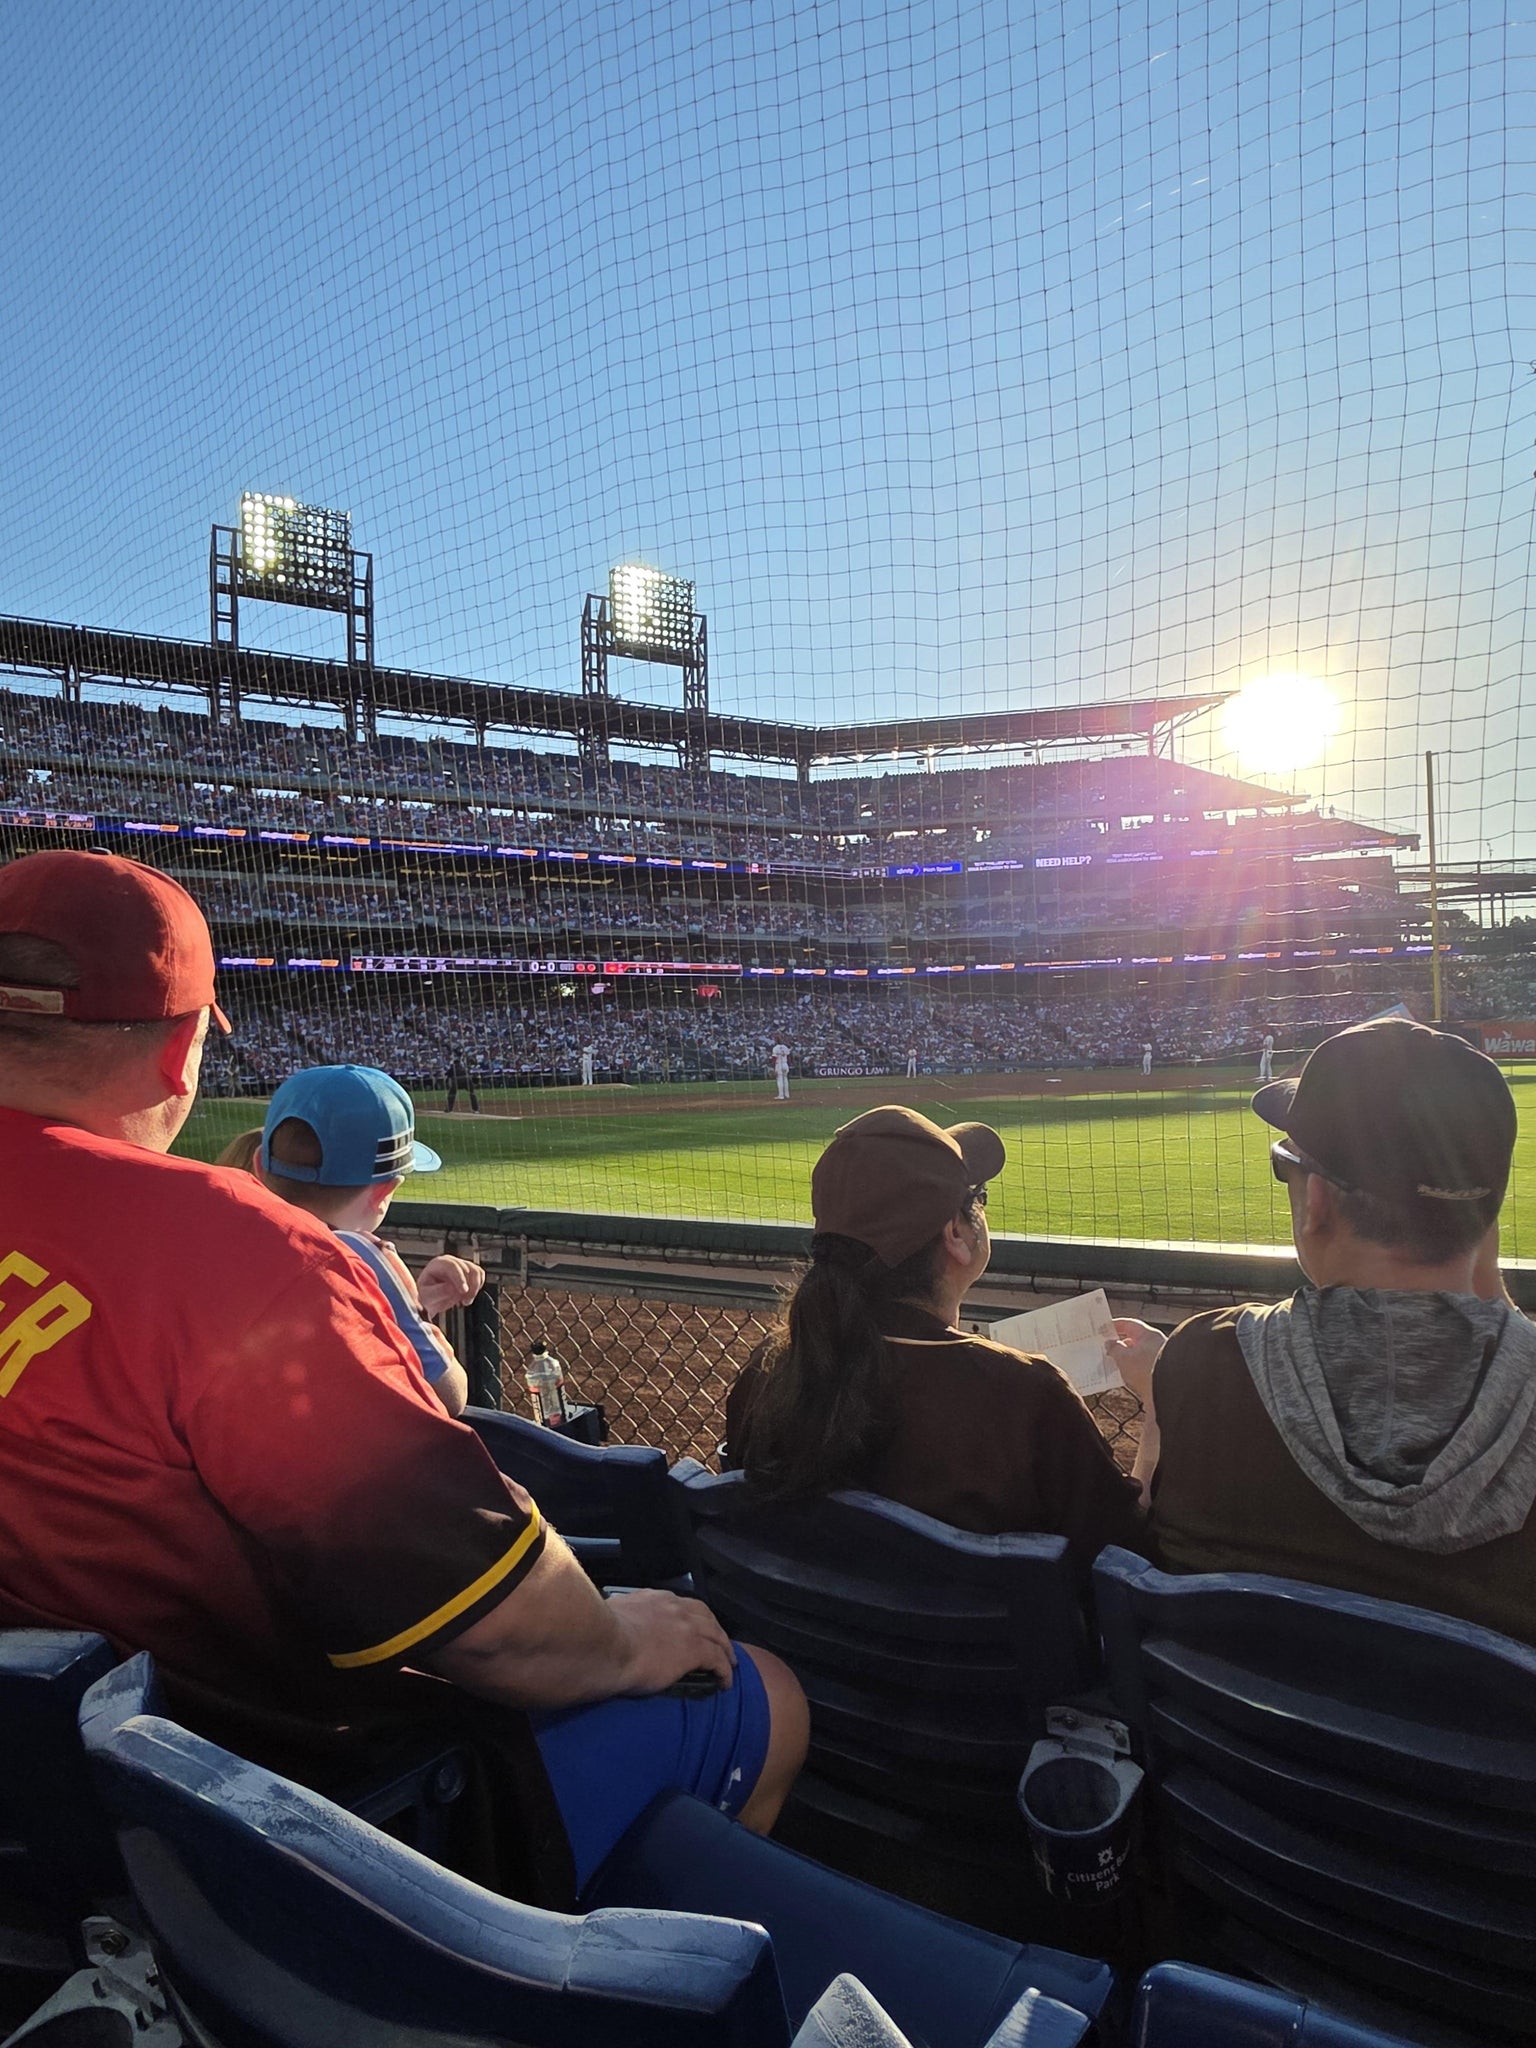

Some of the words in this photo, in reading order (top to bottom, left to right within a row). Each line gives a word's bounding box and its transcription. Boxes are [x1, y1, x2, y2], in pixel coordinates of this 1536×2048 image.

[1035, 857, 1061, 868] NEED
[1062, 855, 1092, 866] HELP?
[531, 961, 556, 972] 0-0
[1484, 1037, 1536, 1053] Wawa
[819, 1067, 863, 1077] GRUNGO
[865, 1066, 885, 1076] LAW
[1095, 1871, 1121, 1892] Park
